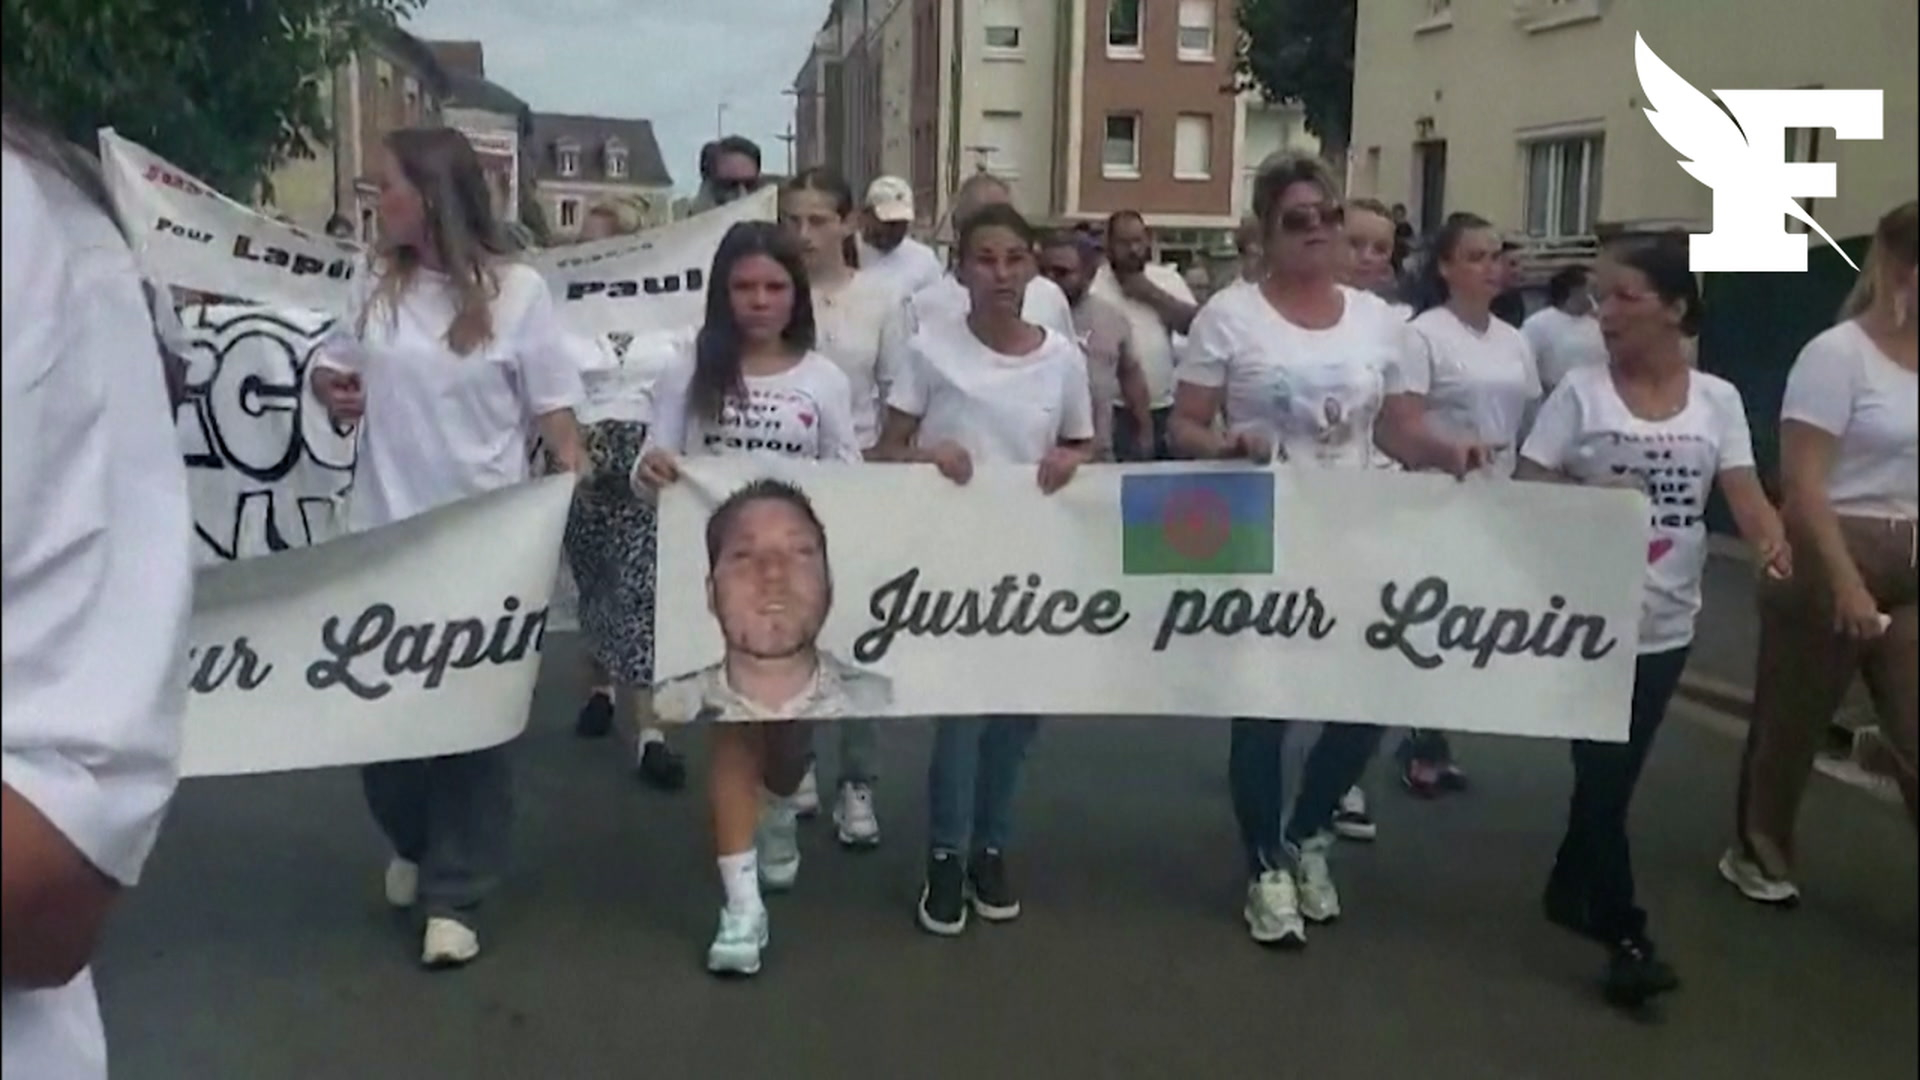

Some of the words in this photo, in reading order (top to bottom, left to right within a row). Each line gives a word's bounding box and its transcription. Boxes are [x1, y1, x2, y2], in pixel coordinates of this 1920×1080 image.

[155, 216, 215, 244] Pour
[566, 267, 703, 300] Paul
[853, 567, 1131, 664] Justice
[1152, 586, 1336, 652] pour
[1364, 575, 1618, 670] Lapin
